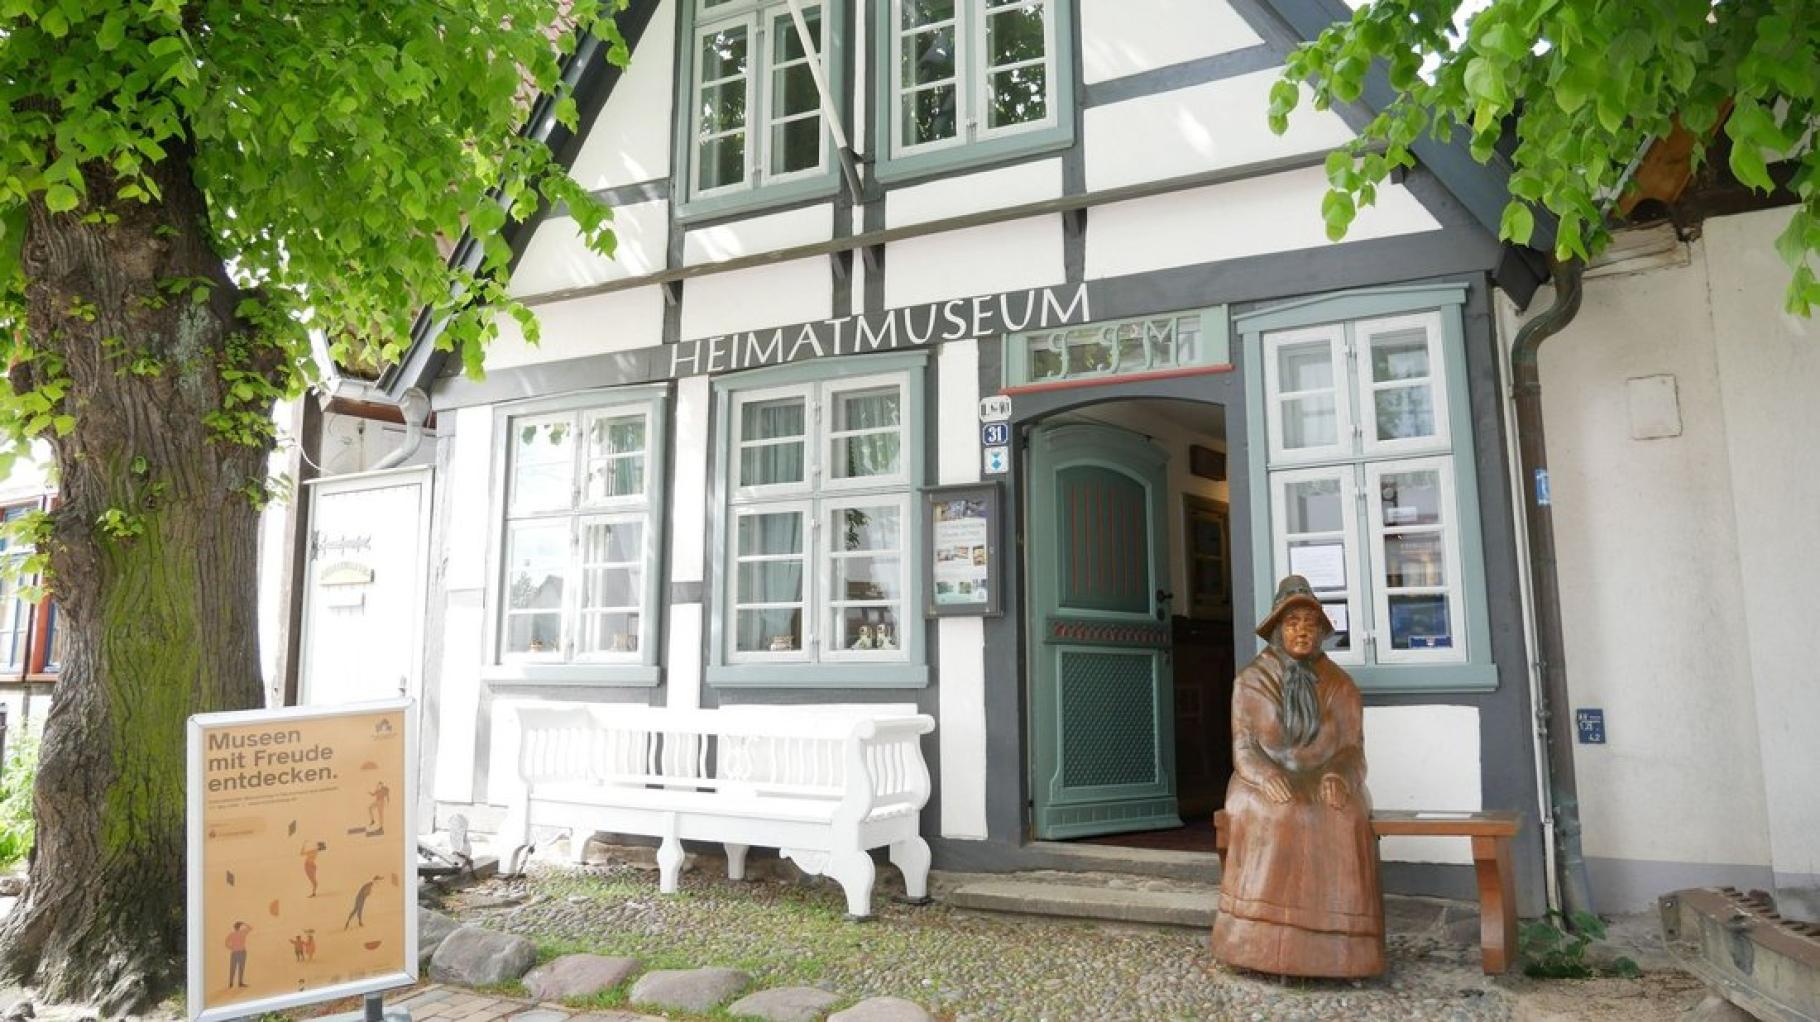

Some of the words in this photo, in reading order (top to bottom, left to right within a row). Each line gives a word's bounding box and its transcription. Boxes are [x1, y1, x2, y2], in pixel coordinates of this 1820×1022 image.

[669, 281, 1092, 378] HEIMATMUSEUM
[987, 425, 1002, 442] 31
[208, 730, 301, 750] Museen
[208, 751, 246, 772] mit
[254, 744, 334, 767] Freude
[207, 766, 338, 792] entdecken.
